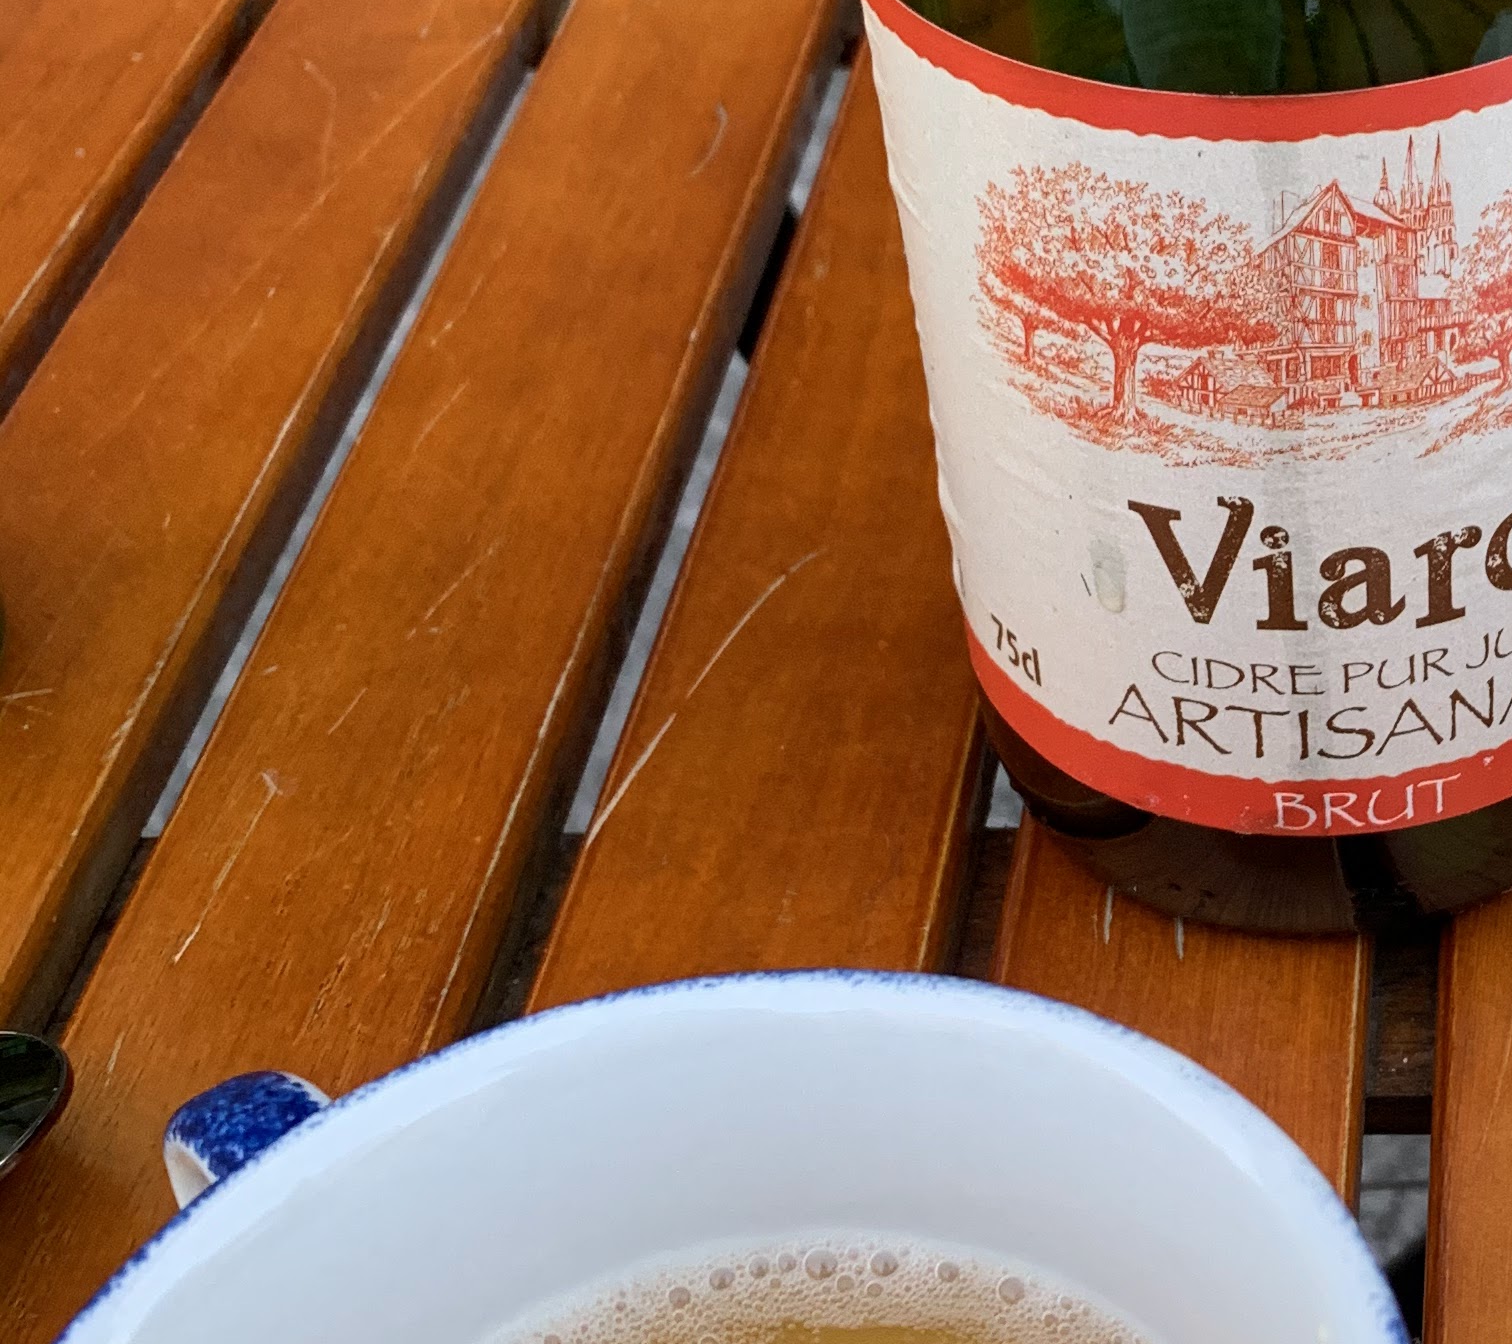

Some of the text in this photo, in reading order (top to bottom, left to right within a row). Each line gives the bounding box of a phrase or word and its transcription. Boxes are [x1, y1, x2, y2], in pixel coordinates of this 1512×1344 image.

[990, 612, 1042, 687] 75cl
[1151, 650, 1325, 696] CIDRE
[1341, 646, 1455, 694] PUR
[1272, 772, 1462, 831] BRUT
